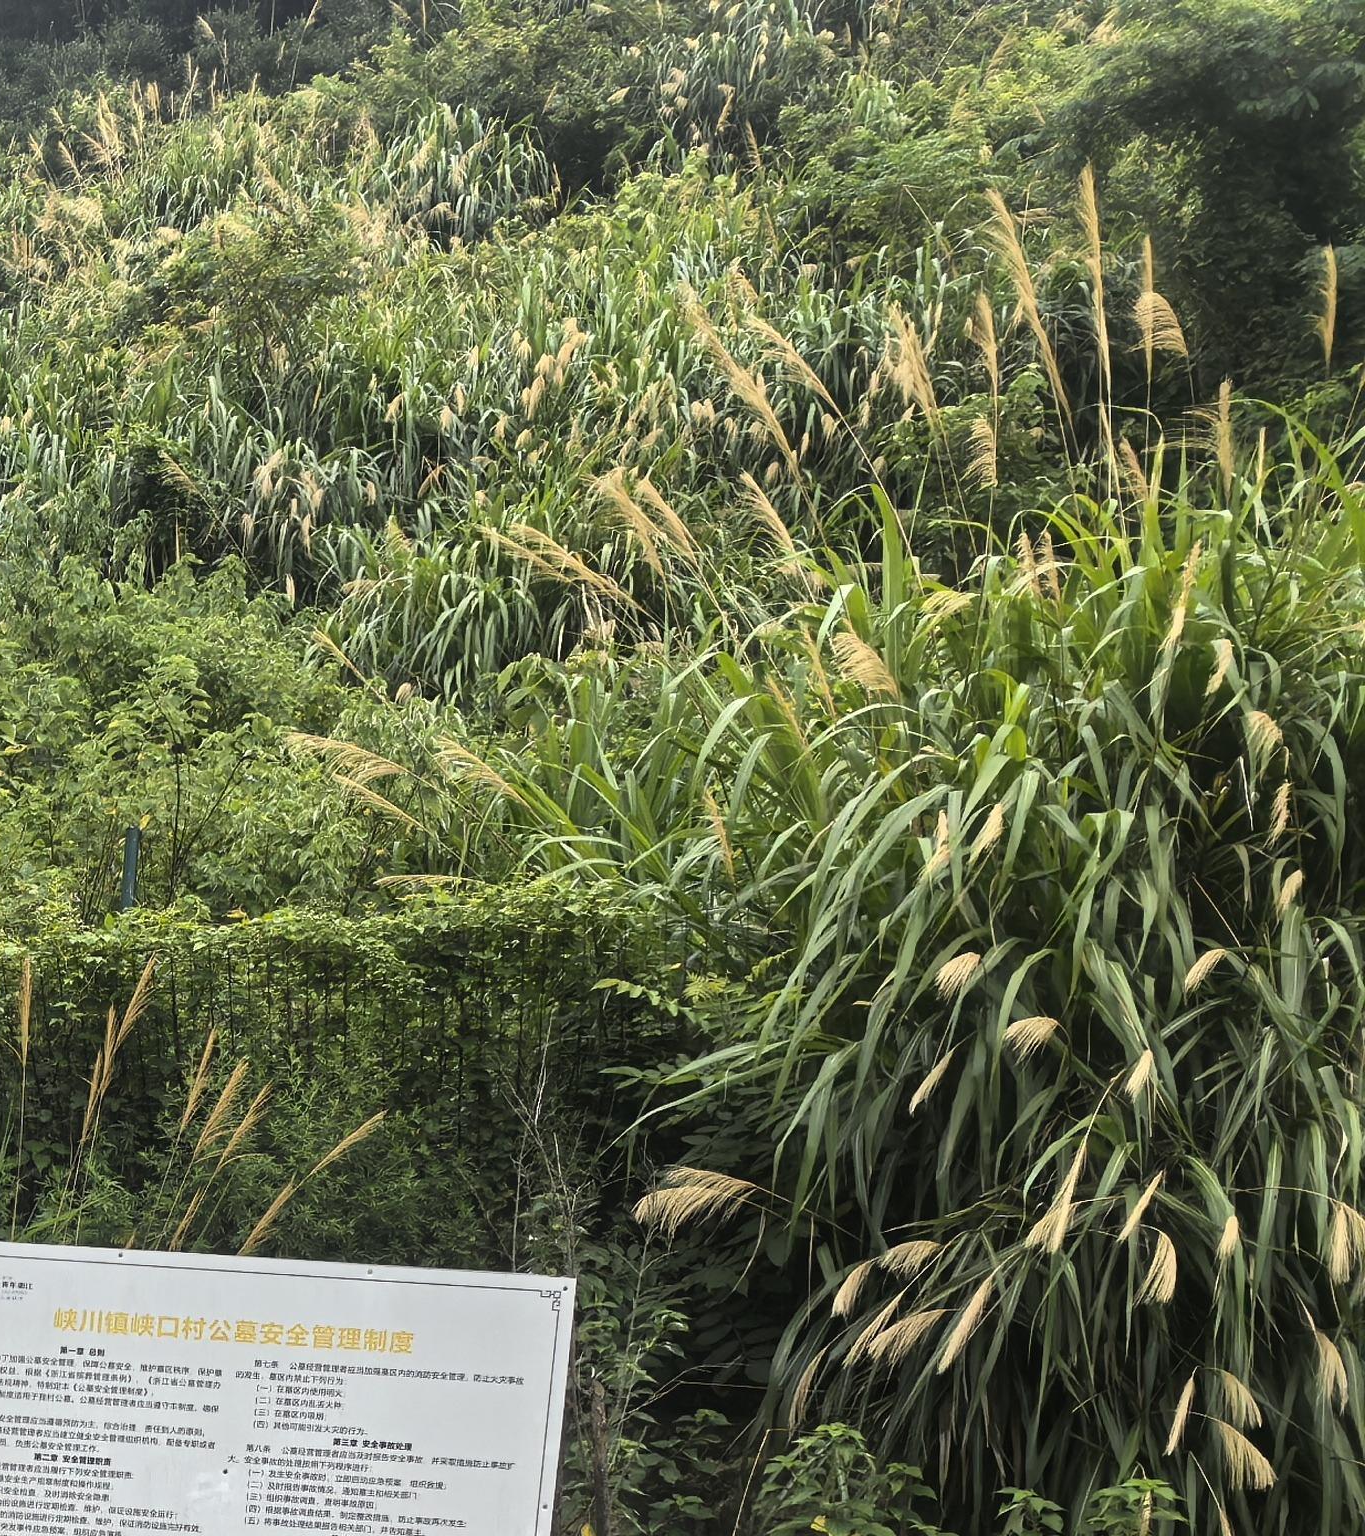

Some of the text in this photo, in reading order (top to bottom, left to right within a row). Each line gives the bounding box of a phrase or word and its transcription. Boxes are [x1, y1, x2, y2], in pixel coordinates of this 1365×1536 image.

[52, 1307, 415, 1354] 峡川镇峡口村公墓安全管理制度
